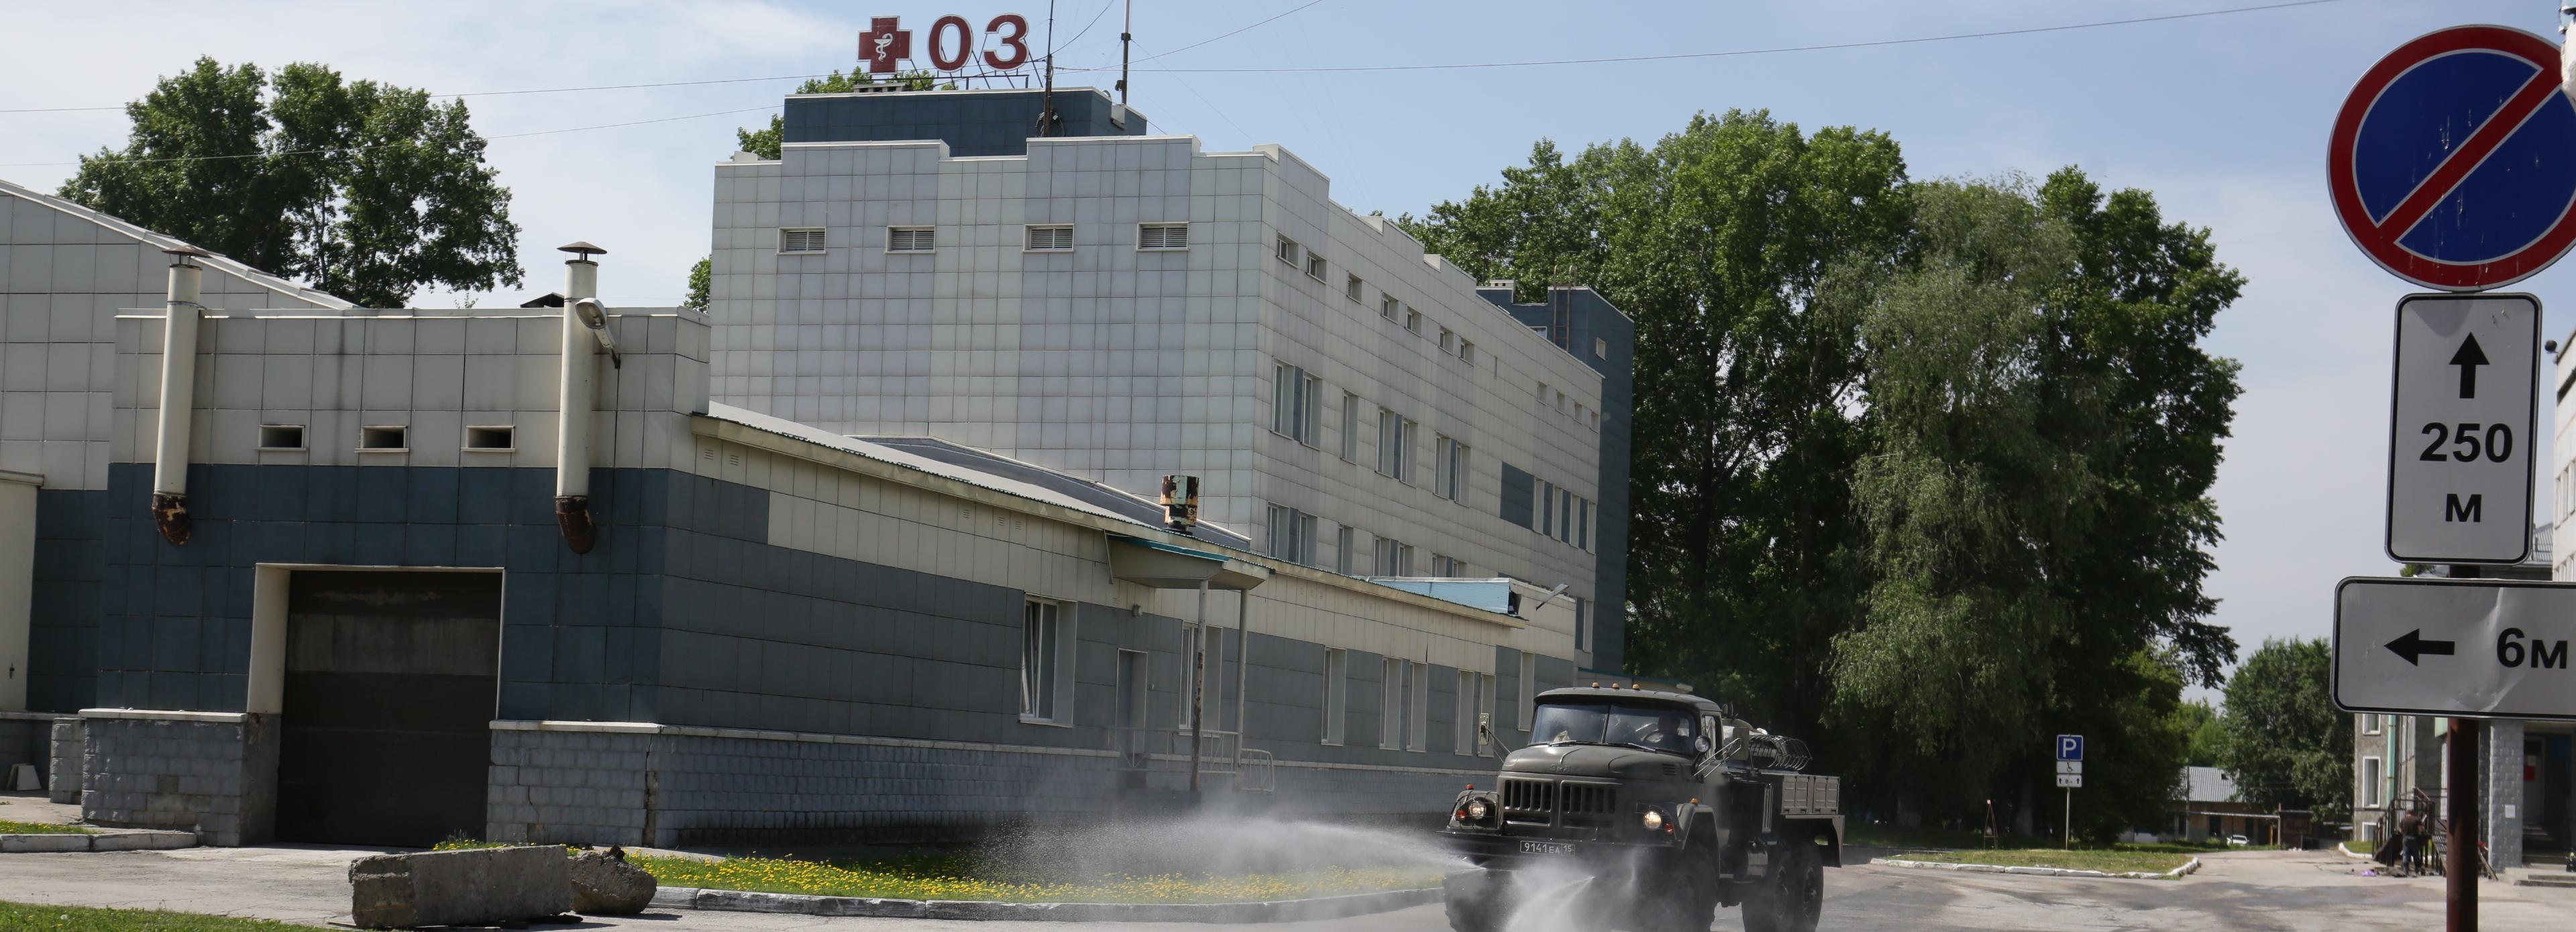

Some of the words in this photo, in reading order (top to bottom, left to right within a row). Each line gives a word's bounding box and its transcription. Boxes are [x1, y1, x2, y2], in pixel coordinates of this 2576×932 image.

[928, 13, 1030, 73] 03
[2419, 422, 2513, 463] 250
[2063, 738, 2077, 758] P
